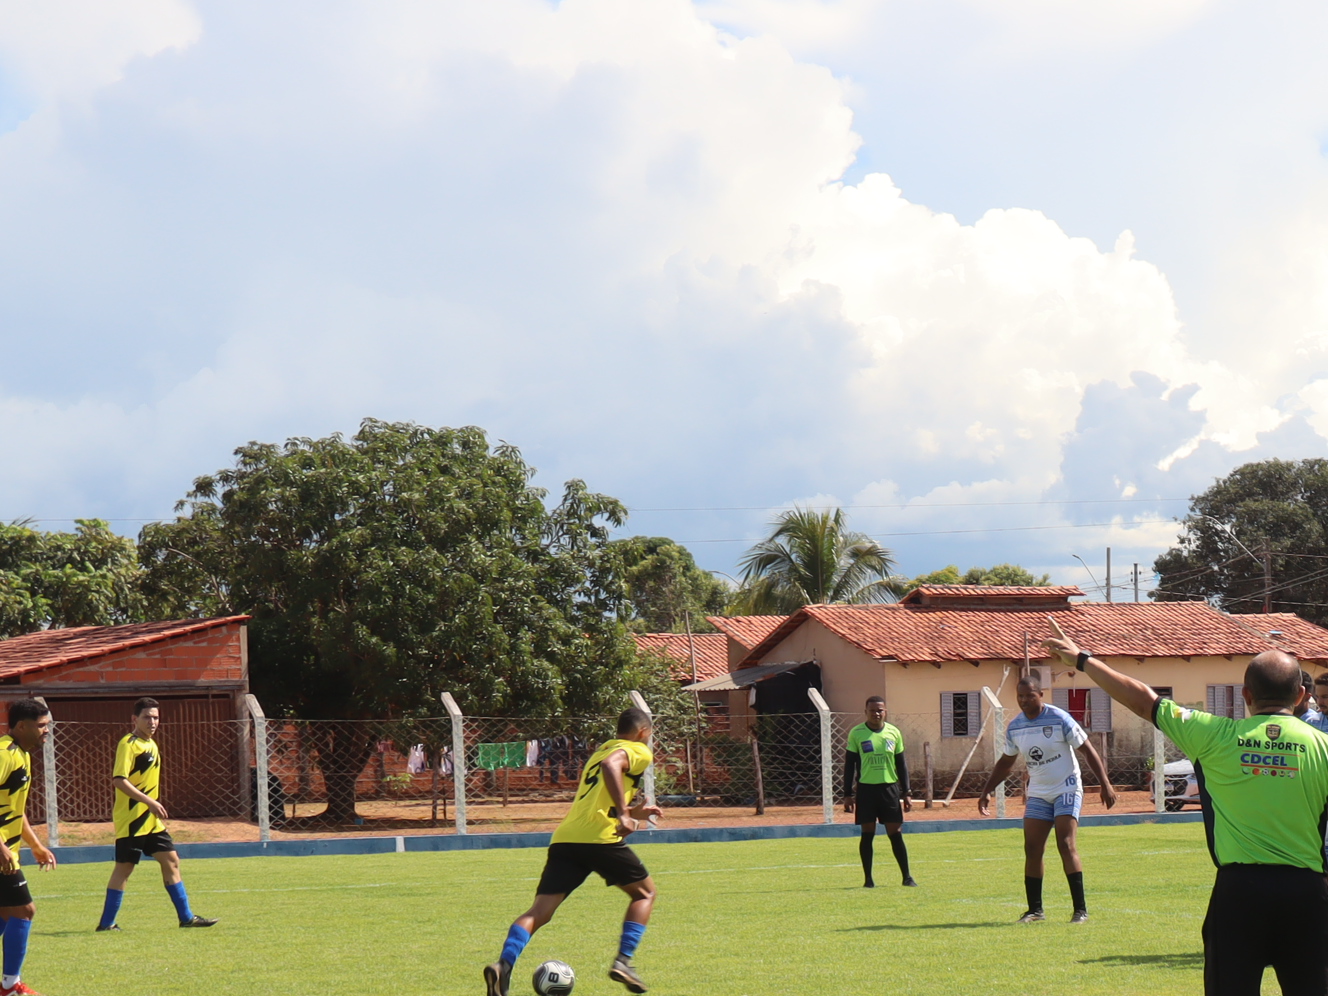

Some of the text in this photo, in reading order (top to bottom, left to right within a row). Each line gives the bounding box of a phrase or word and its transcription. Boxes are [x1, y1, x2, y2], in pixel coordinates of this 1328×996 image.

[1237, 738, 1306, 752] D&N SPORTS
[1240, 753, 1288, 766] CDCEL
[1065, 775, 1076, 787] 16
[1061, 793, 1074, 805] 16
